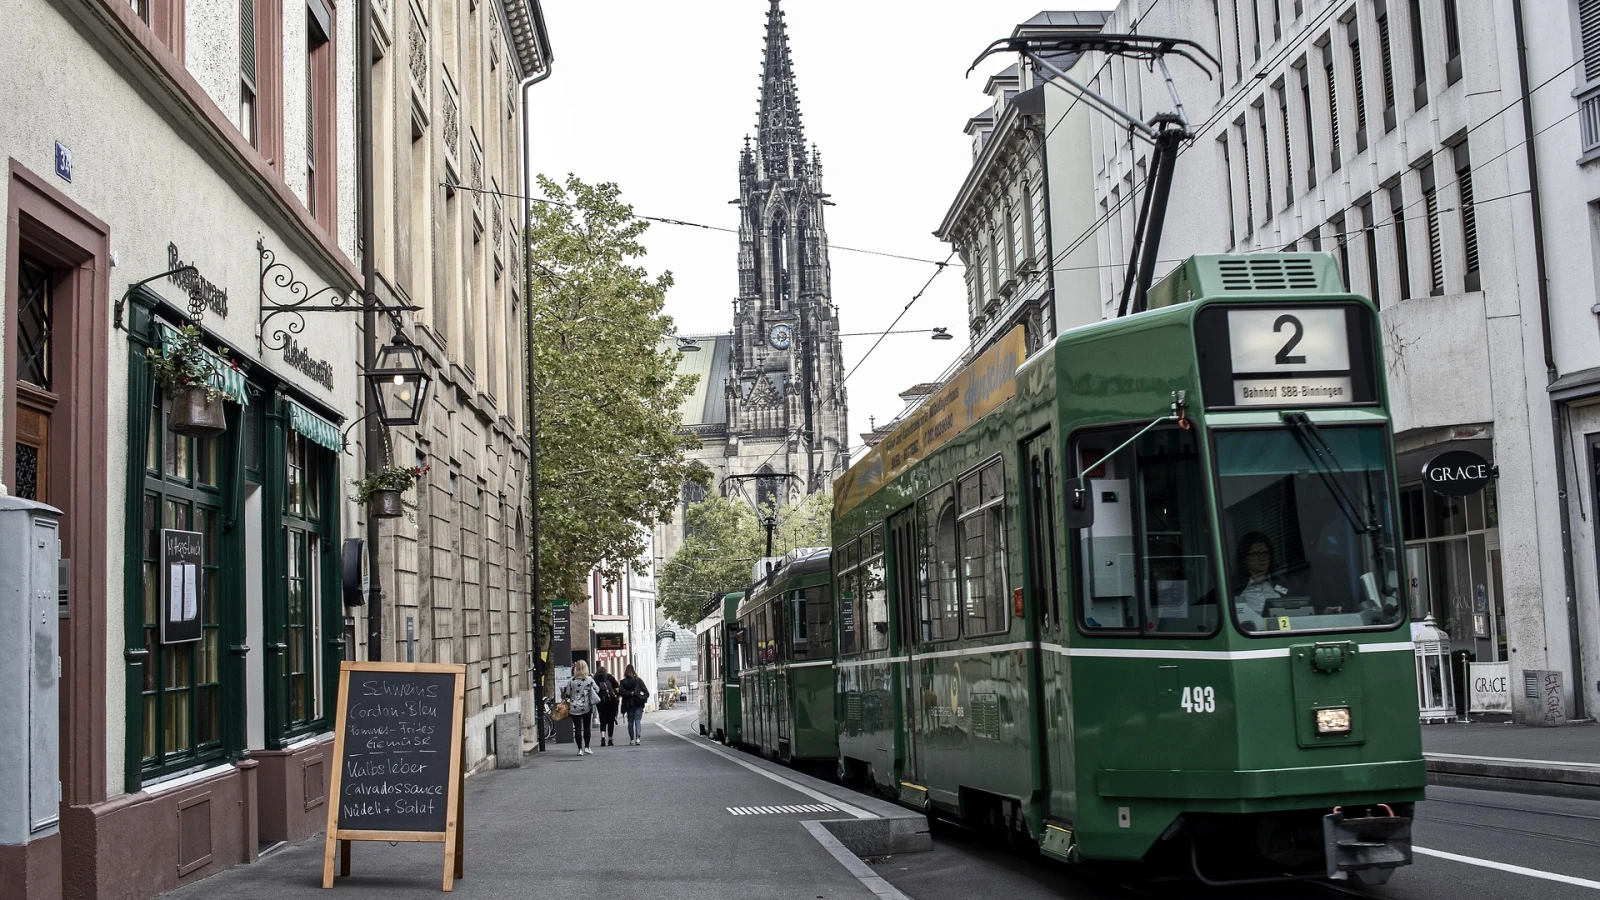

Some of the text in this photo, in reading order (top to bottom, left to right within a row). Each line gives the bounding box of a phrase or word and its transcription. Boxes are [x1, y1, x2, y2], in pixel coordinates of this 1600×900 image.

[1273, 314, 1306, 365] 2
[1243, 385, 1344, 398] Bahnhof SBB-Binningen
[1430, 464, 1488, 482] GRACE
[1281, 619, 1288, 628] 2
[362, 680, 439, 698] Schweins
[1475, 677, 1507, 693] GRACE
[1181, 686, 1216, 713] 493
[366, 736, 431, 749] Gemüse
[347, 757, 428, 778] Kalbsleber
[345, 781, 443, 796] Calvadossauce
[395, 799, 435, 815] Salat
